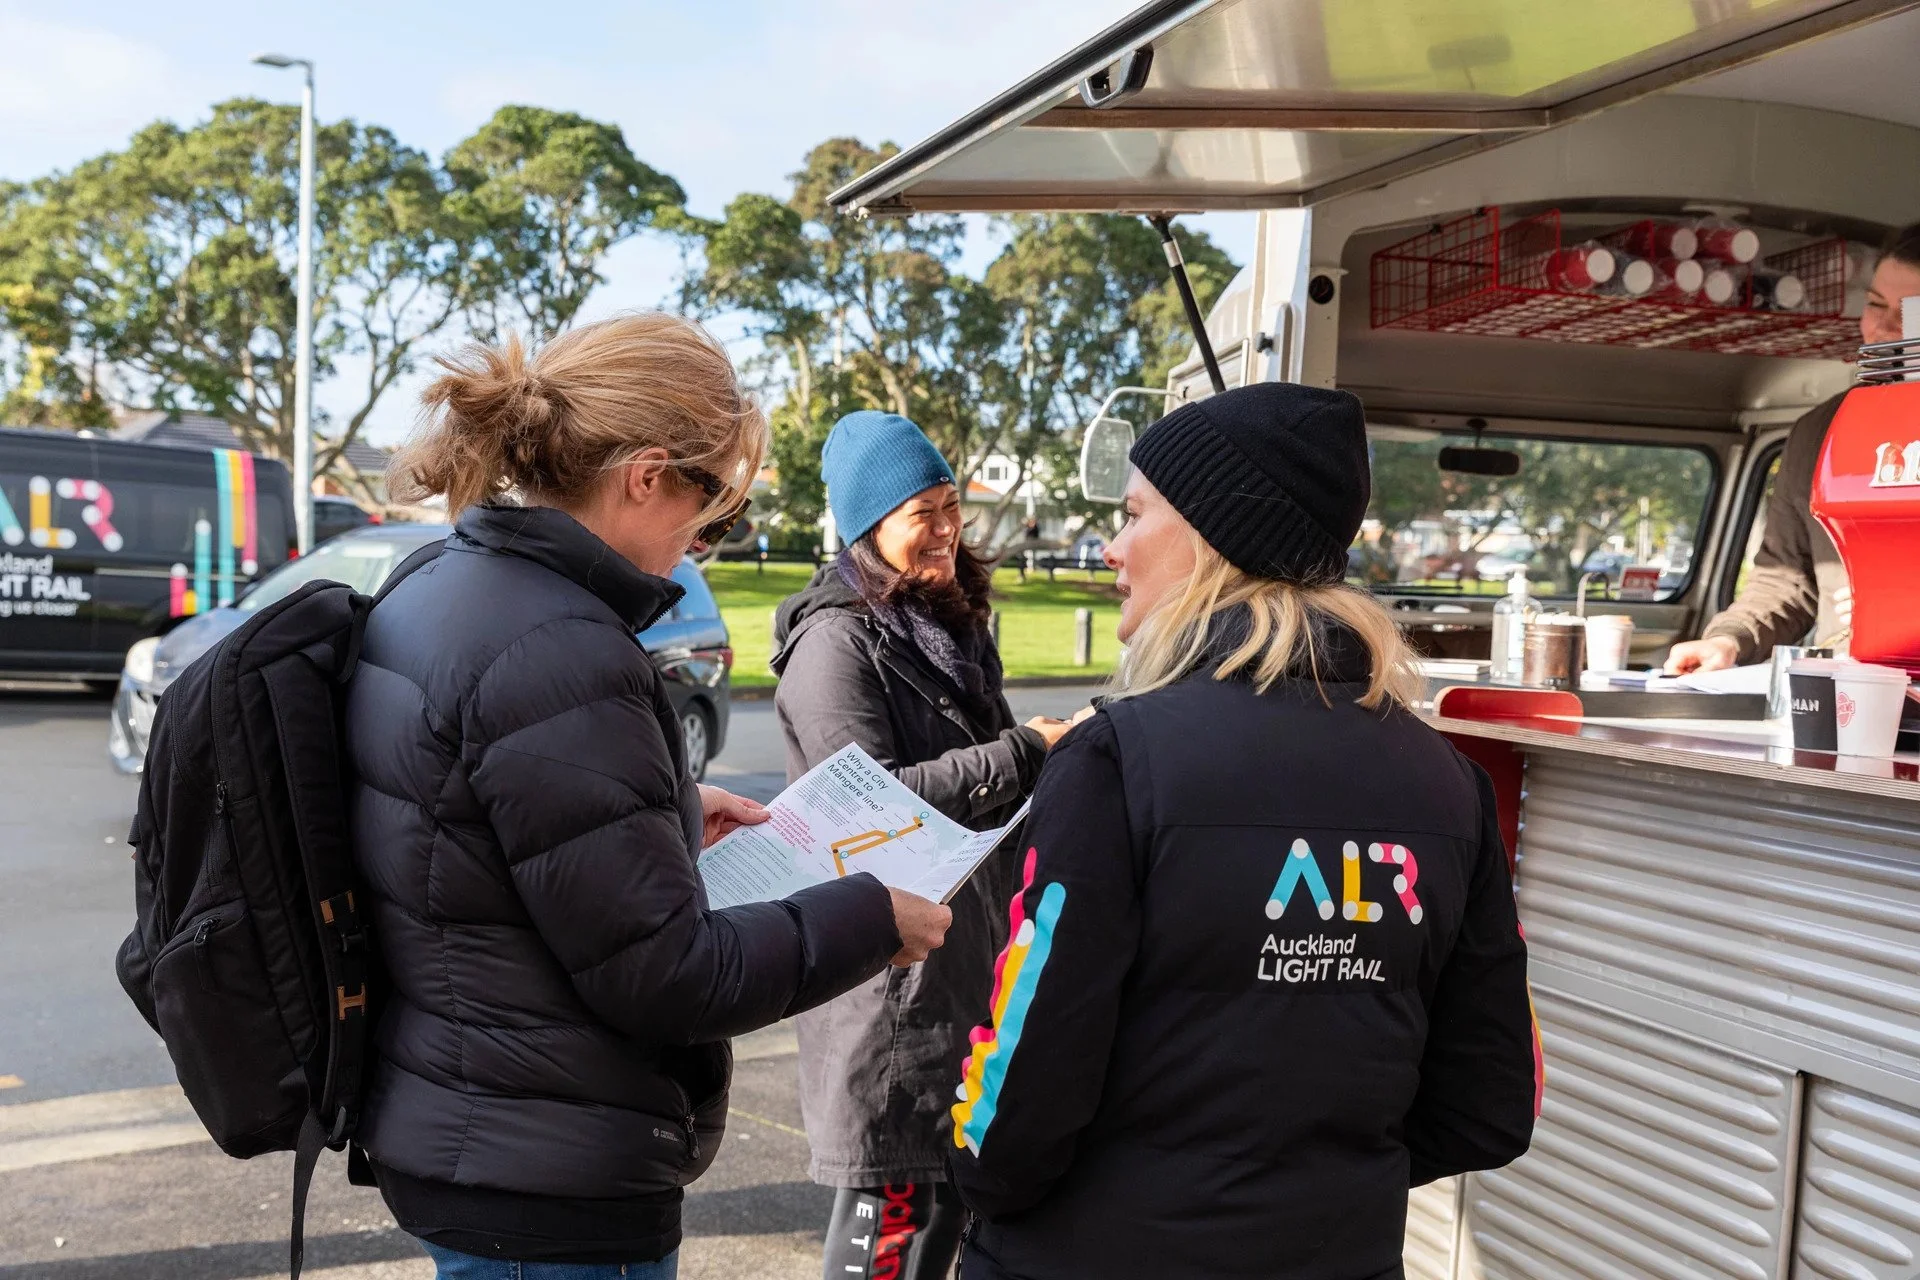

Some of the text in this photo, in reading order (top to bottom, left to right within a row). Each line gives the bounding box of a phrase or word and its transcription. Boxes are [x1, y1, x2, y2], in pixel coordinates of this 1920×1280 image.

[31, 576, 91, 601] RAIL
[837, 758, 873, 791] Centre to
[846, 752, 865, 770] Why
[871, 774, 888, 790] City
[862, 795, 883, 812] line?
[1265, 838, 1423, 925] ALR
[1260, 933, 1356, 956] Auckland
[1257, 958, 1385, 983] LIGHT RAIL
